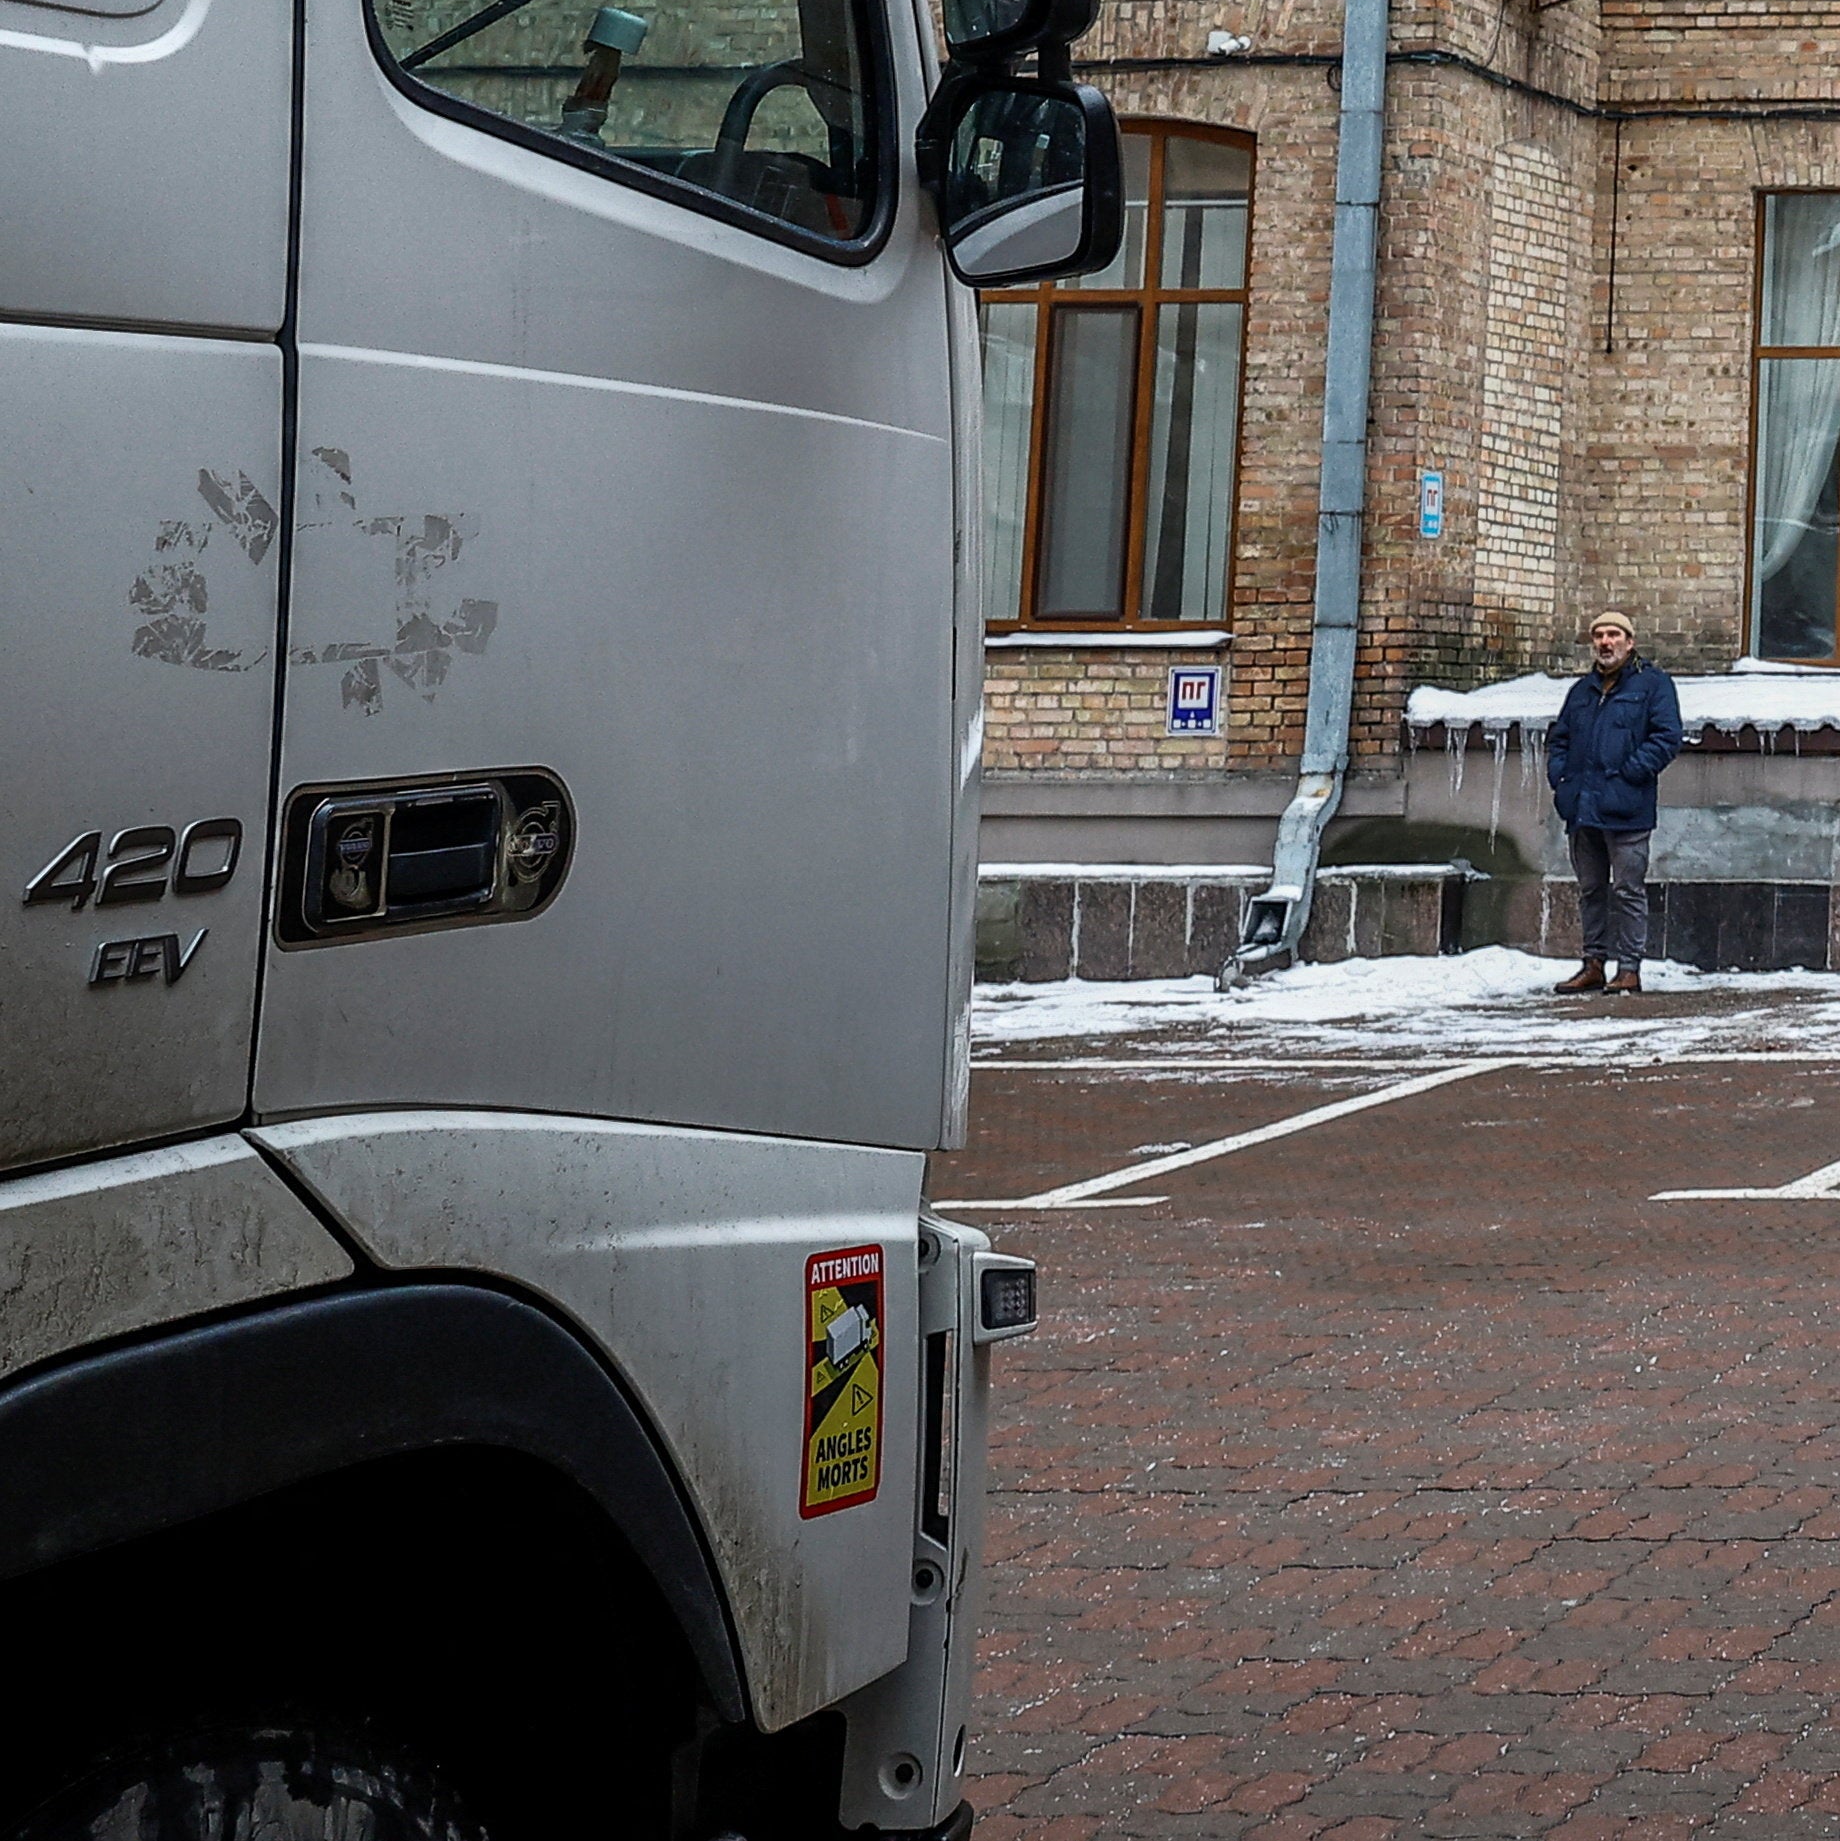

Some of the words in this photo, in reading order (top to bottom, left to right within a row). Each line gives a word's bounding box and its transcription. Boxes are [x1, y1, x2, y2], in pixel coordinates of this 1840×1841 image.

[1181, 681, 1207, 701] ПГ
[22, 816, 244, 912] 420
[88, 927, 210, 988] EEV
[810, 1251, 880, 1285] ATTENTION
[815, 1426, 872, 1464] ANGLES
[817, 1456, 868, 1492] MORTS
